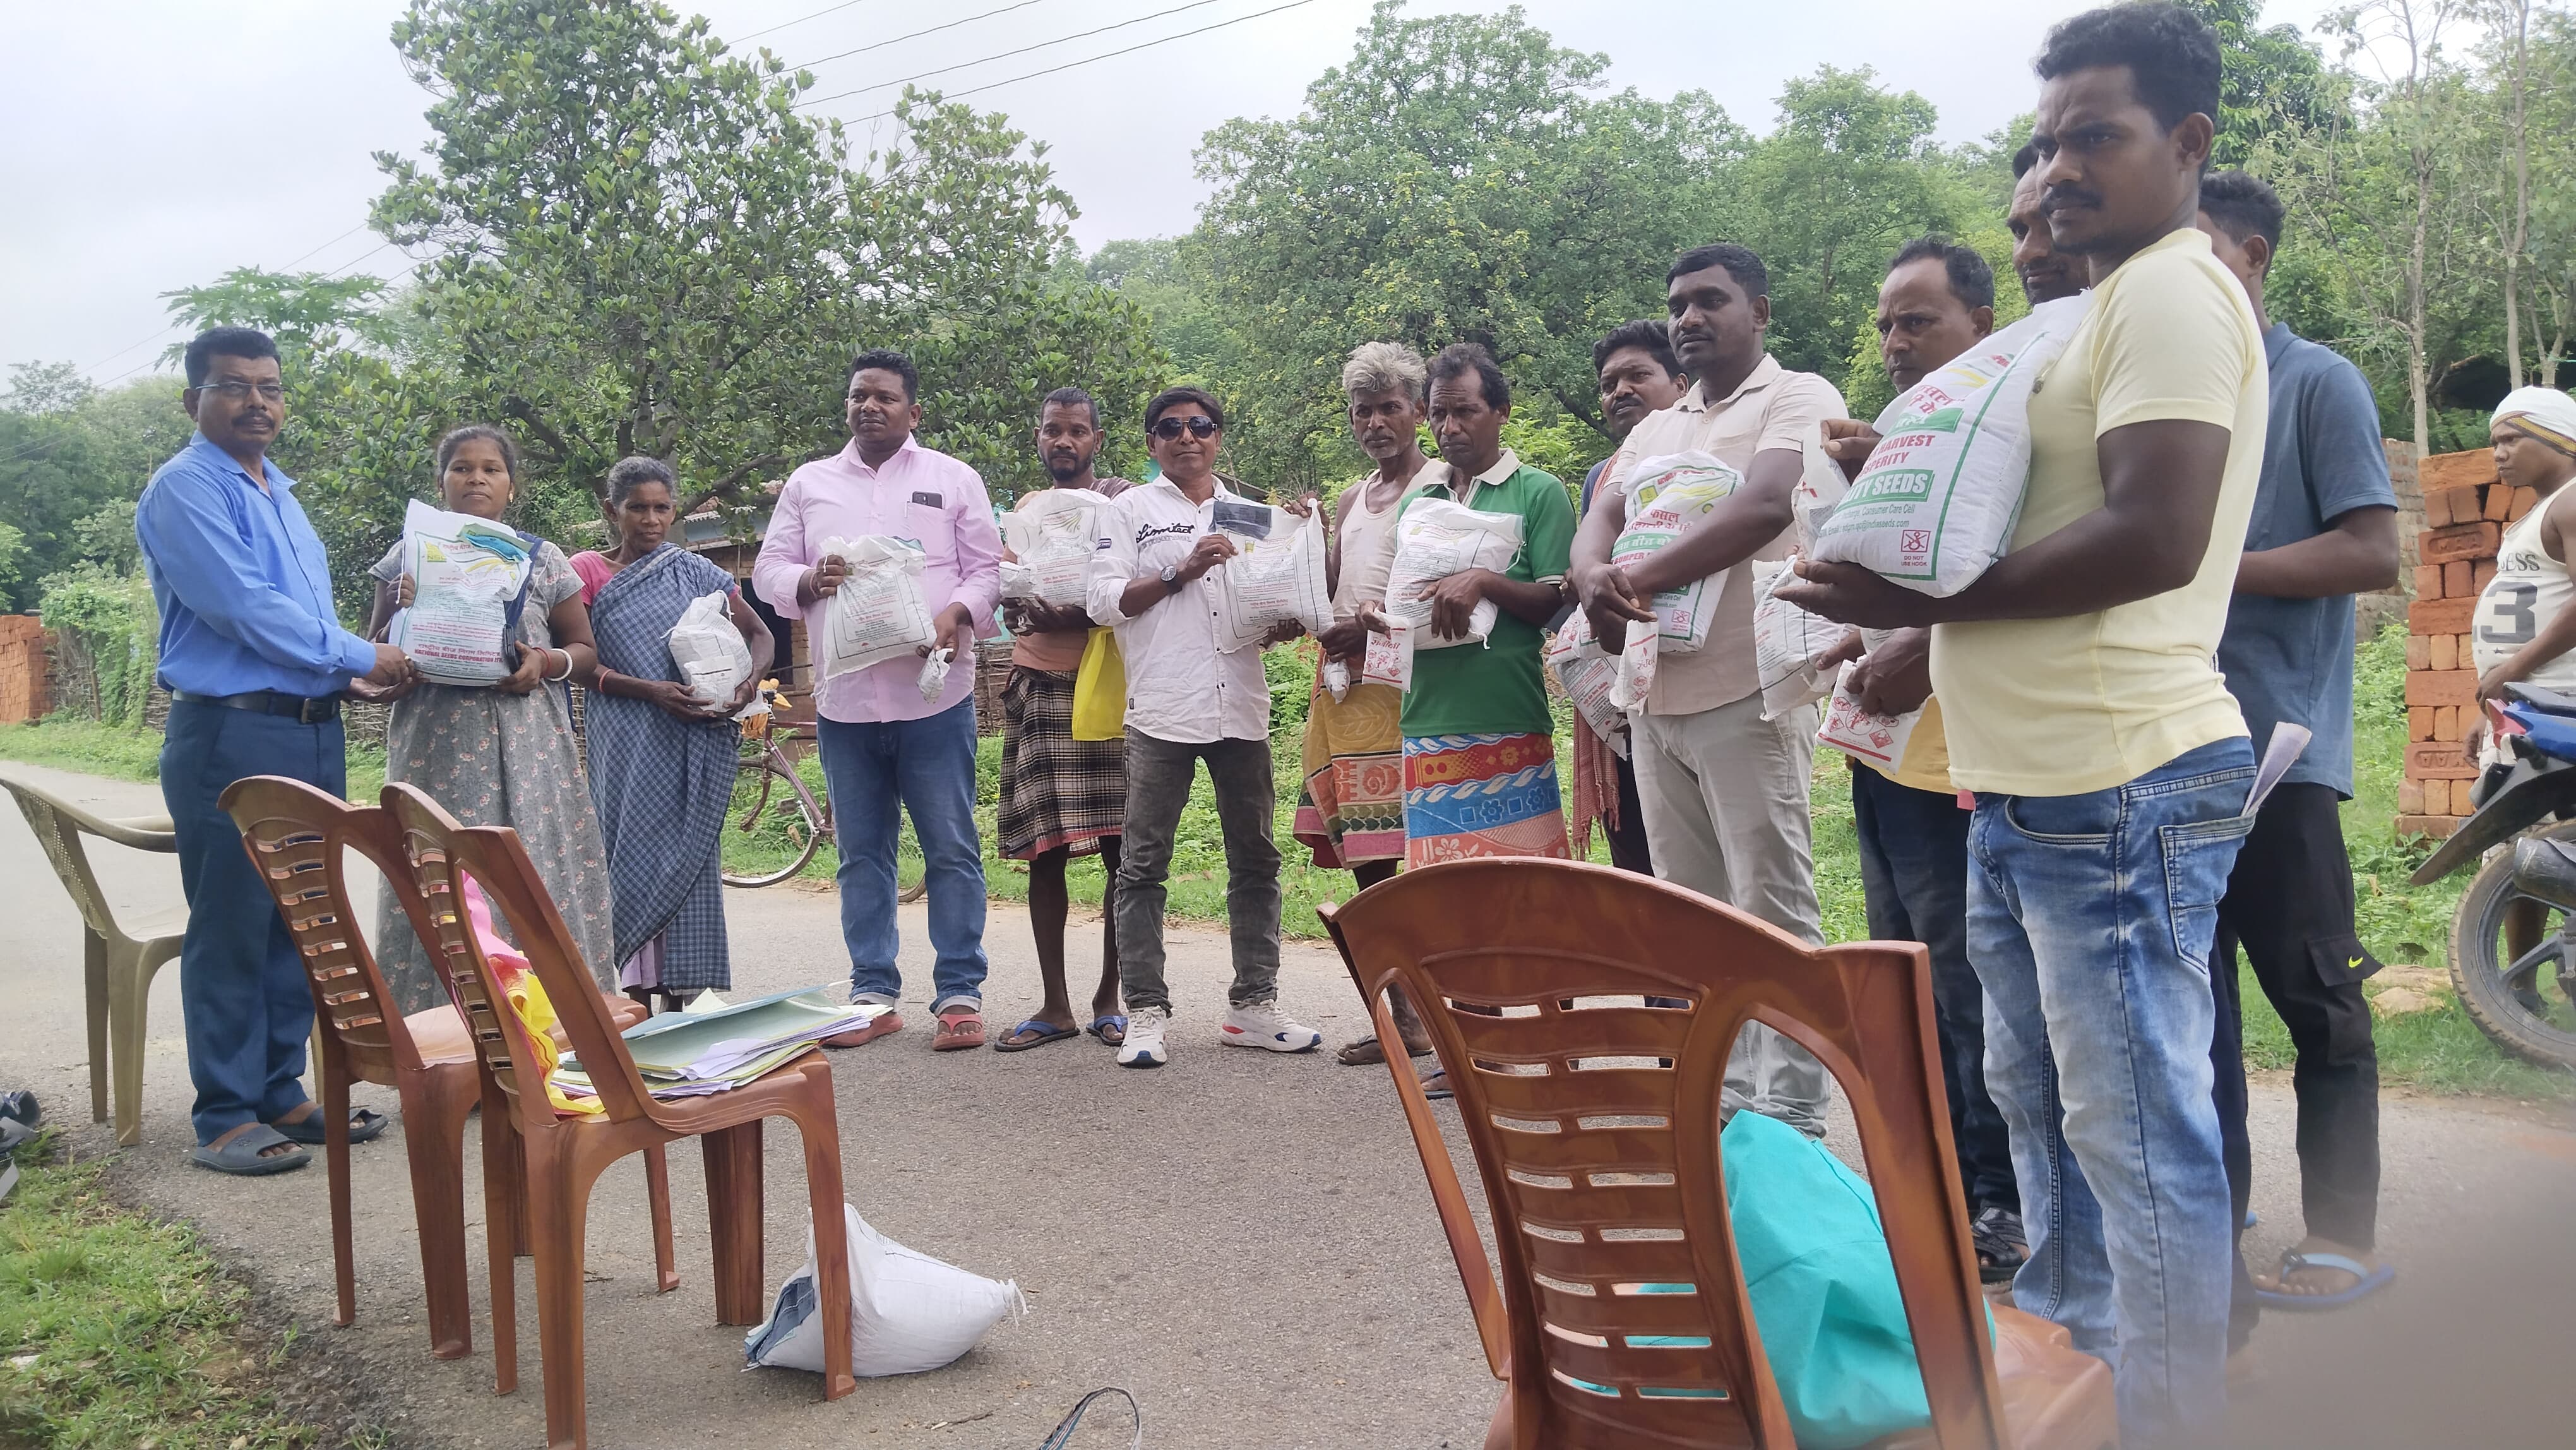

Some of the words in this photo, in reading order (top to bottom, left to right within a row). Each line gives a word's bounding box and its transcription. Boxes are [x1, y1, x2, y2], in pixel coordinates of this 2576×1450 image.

[1878, 434, 1936, 455] HARVEST
[1871, 472, 1928, 495] SEEDS
[1889, 503, 1903, 515] Care
[1903, 503, 1916, 514] Cell
[2472, 580, 2538, 644] 3
